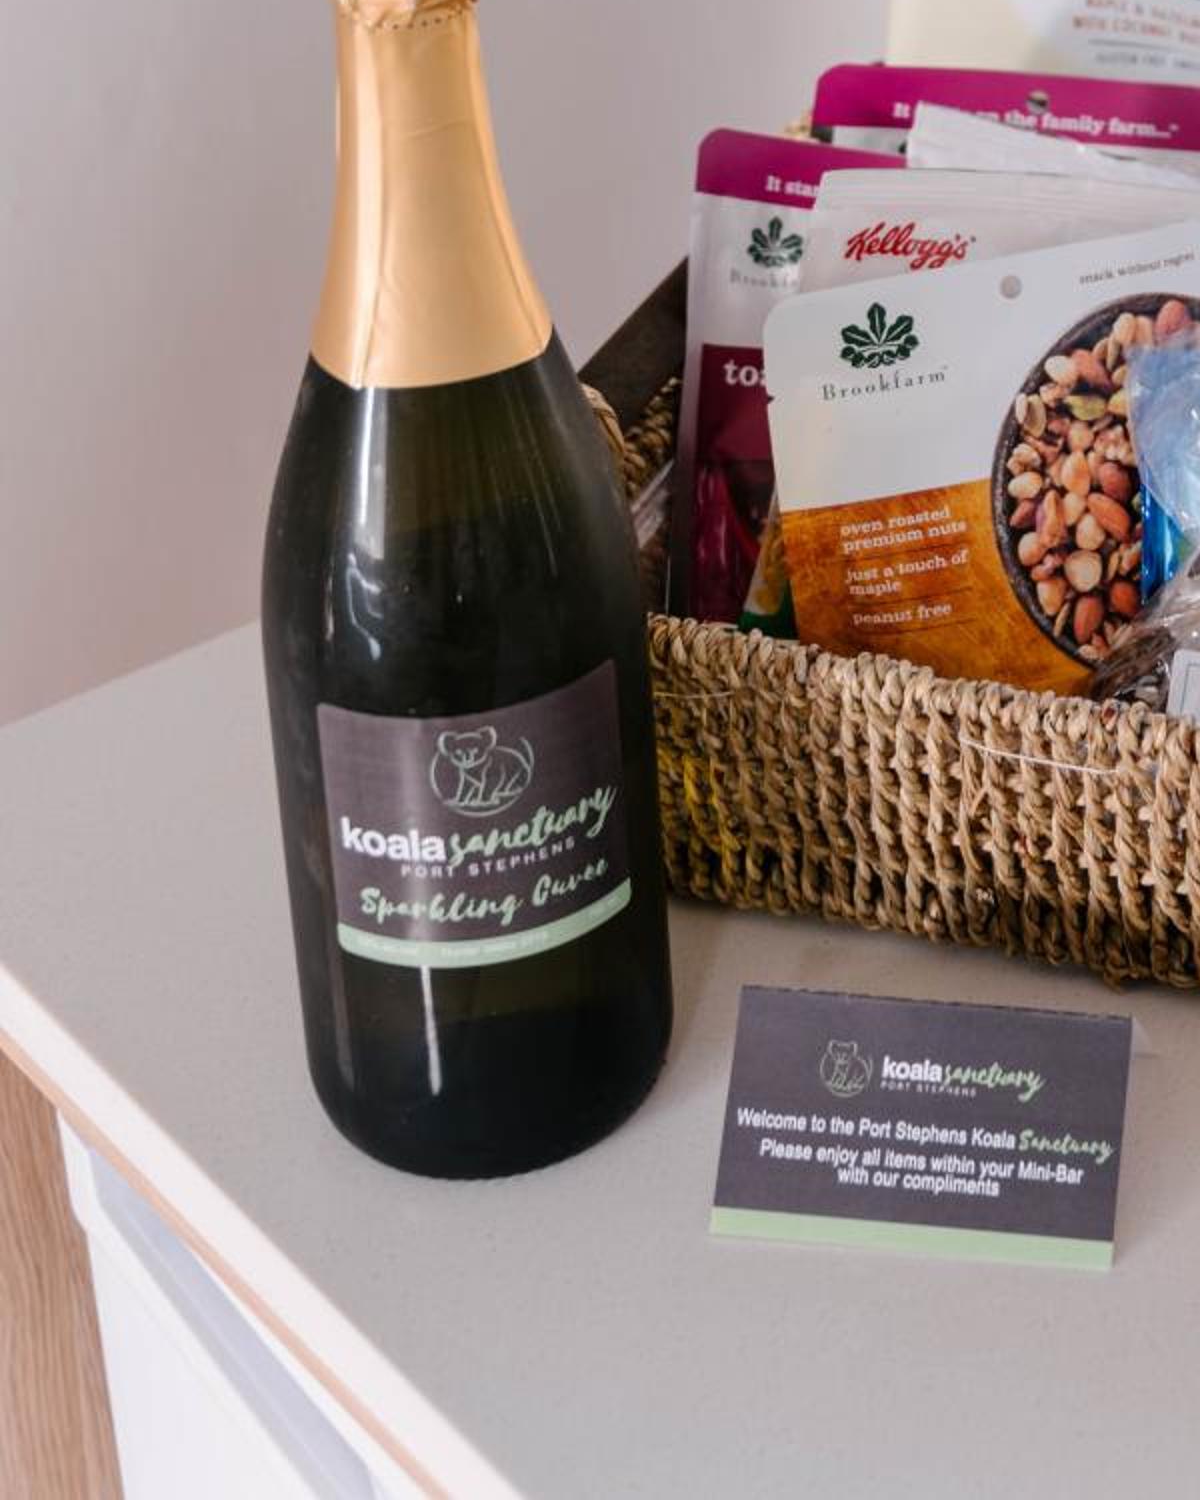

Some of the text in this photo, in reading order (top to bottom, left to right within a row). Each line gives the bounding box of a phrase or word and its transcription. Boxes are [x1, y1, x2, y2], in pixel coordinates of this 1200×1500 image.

[1041, 112, 1105, 136] family
[845, 220, 972, 271] Kellogg's
[821, 368, 946, 401] Brookfarm
[840, 505, 951, 538] oven roasted
[842, 518, 968, 554] premium nuts
[845, 549, 969, 584] just a touch of
[849, 579, 902, 597] maple
[852, 601, 953, 626] peanut free
[400, 838, 577, 879] PORT STEPHENS
[359, 886, 525, 926] Sparkling
[880, 1081, 978, 1099] PORT STEPHENS
[736, 1106, 1115, 1164] Welcome to the Port Stephens Koala Sanctuary
[759, 1138, 1084, 1185] Please enjoy all items within your Mini-Bar
[836, 1166, 1001, 1198] with our compliments
